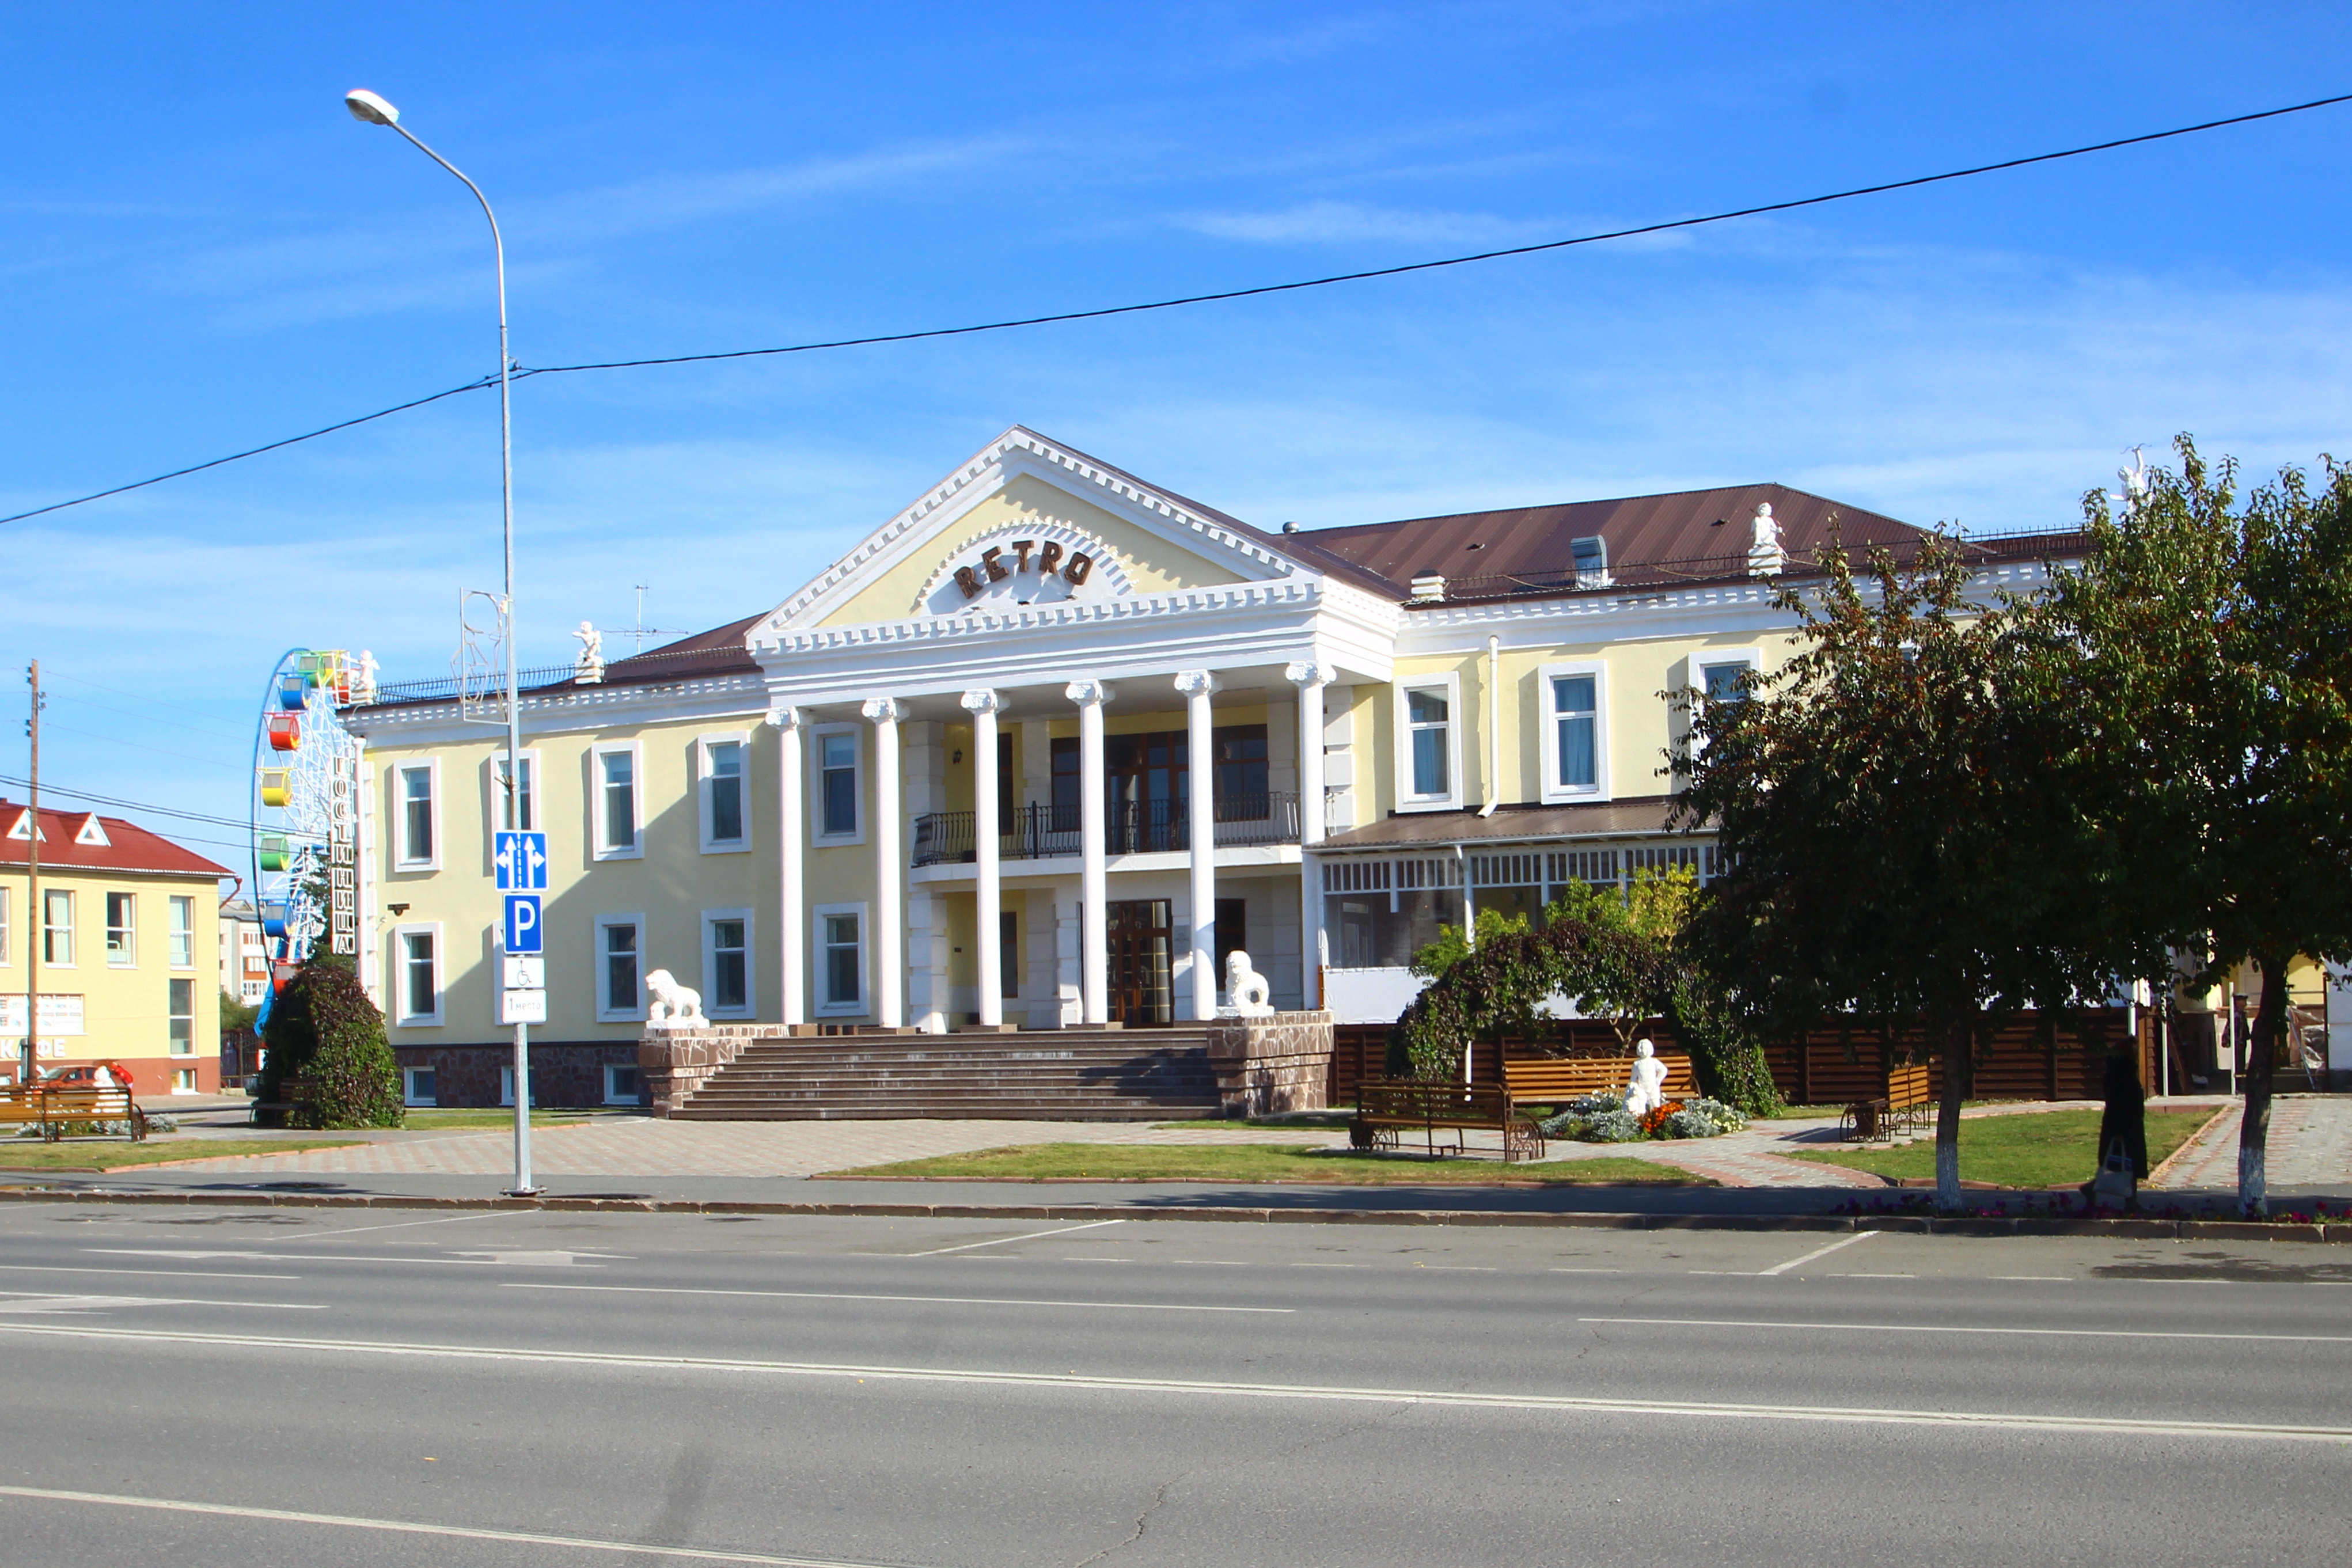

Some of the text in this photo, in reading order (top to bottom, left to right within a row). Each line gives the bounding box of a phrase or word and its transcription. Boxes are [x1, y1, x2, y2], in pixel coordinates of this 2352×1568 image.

[953, 540, 1094, 599] RETRO
[333, 757, 352, 954] ГОСТИНИЦА
[514, 901, 536, 946] P
[510, 997, 541, 1011] 1 место
